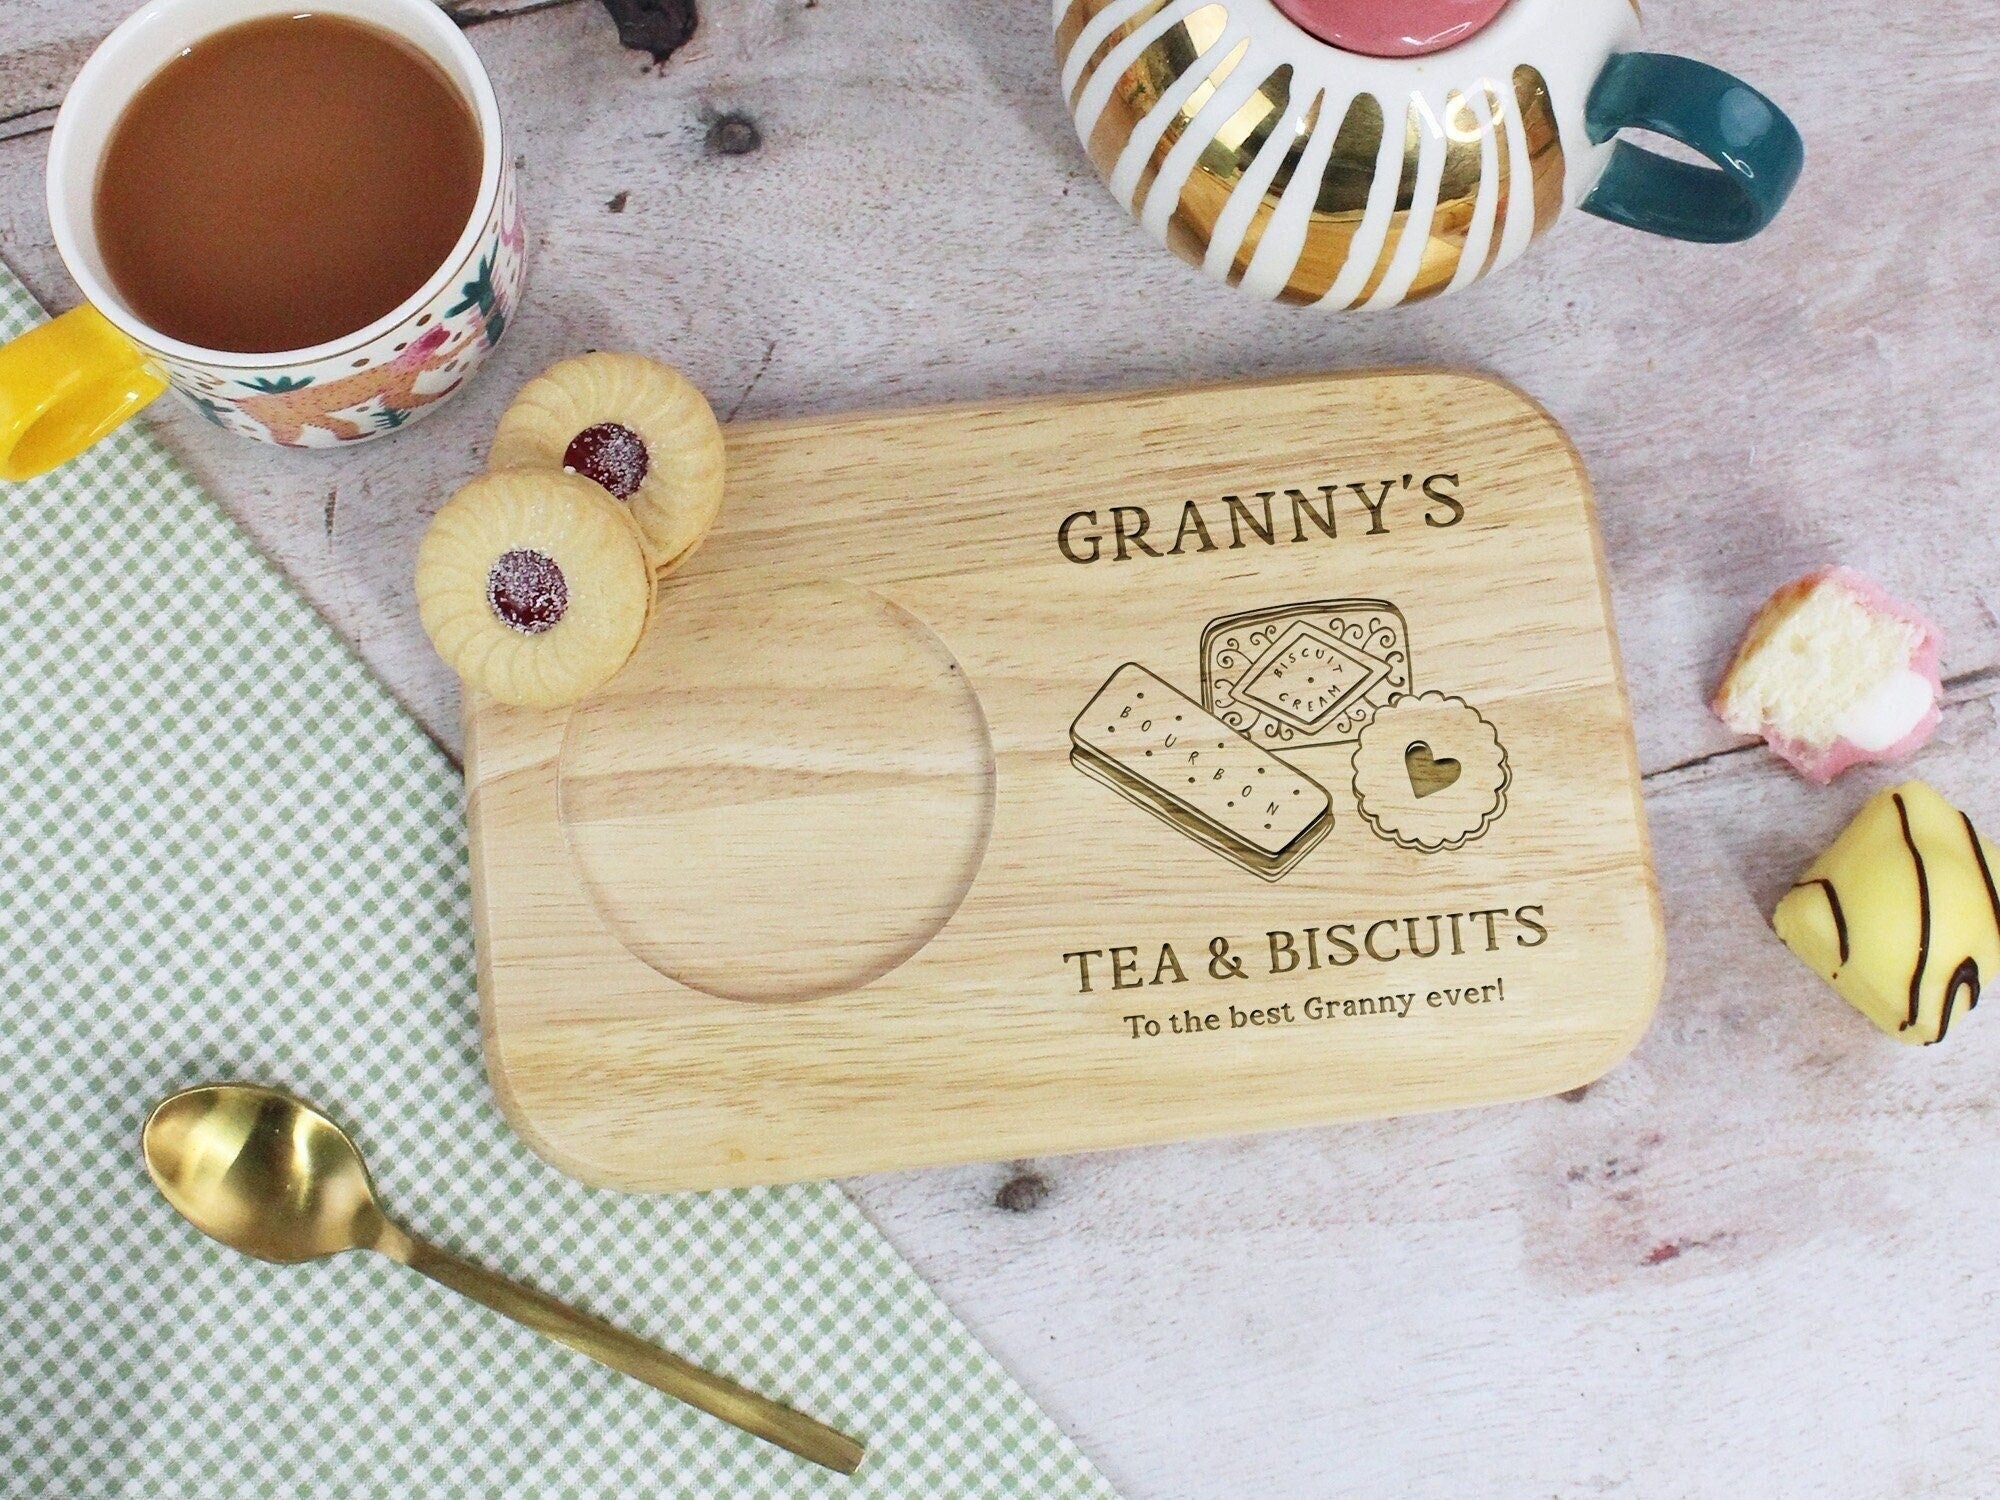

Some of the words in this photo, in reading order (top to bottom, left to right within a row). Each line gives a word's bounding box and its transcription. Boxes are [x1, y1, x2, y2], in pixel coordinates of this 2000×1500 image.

[1058, 473, 1466, 565] GRANNY'S
[1274, 648, 1343, 679] BISCUIT
[1278, 685, 1342, 712] CREAM
[1120, 705, 1279, 816] BOURBON
[1063, 943, 1189, 993] TEA
[1208, 936, 1249, 980] &
[1266, 905, 1549, 974] BISCUITS
[1123, 1014, 1161, 1039] To
[1169, 1010, 1221, 1035] the
[1230, 1002, 1295, 1029] best
[1304, 994, 1416, 1021] Granny
[1426, 978, 1505, 1009] ever!
